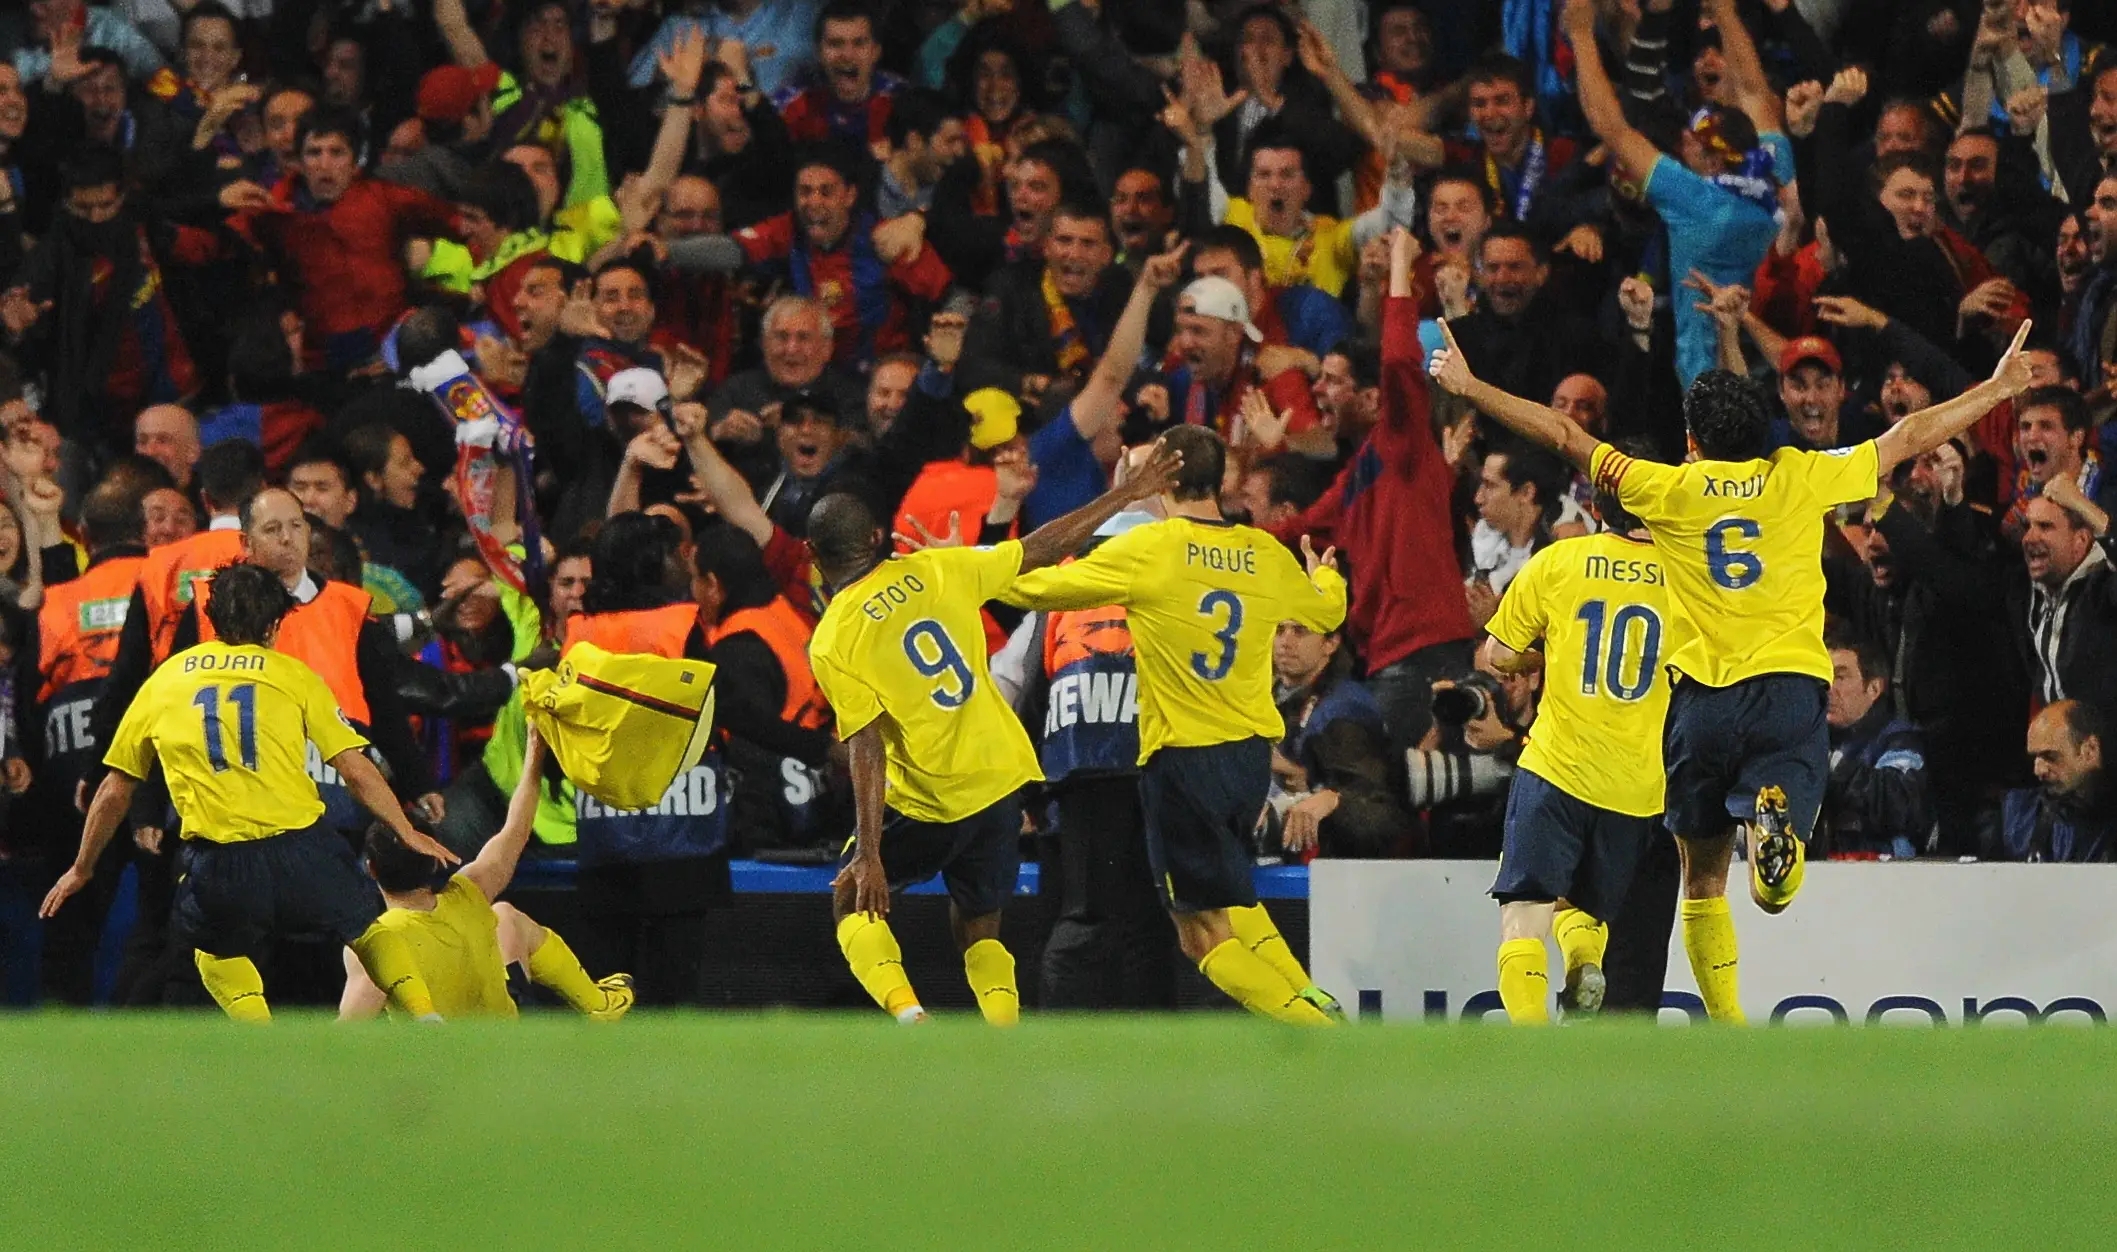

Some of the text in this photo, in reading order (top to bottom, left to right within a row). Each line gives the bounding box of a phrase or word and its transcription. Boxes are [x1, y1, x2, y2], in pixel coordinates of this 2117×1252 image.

[1703, 474, 1763, 498] XAVI
[1187, 543, 1256, 575] PIQUÉ
[1585, 555, 1665, 587] MESSI
[1703, 515, 1765, 591] 6
[863, 574, 924, 620] ETO'O
[184, 654, 265, 673] BOJAN
[902, 618, 976, 711] 9
[1191, 588, 1245, 682] 3
[1576, 599, 1664, 702] 10
[45, 698, 96, 758] TE
[192, 682, 260, 775] 11
[1043, 672, 1140, 739] TEWA
